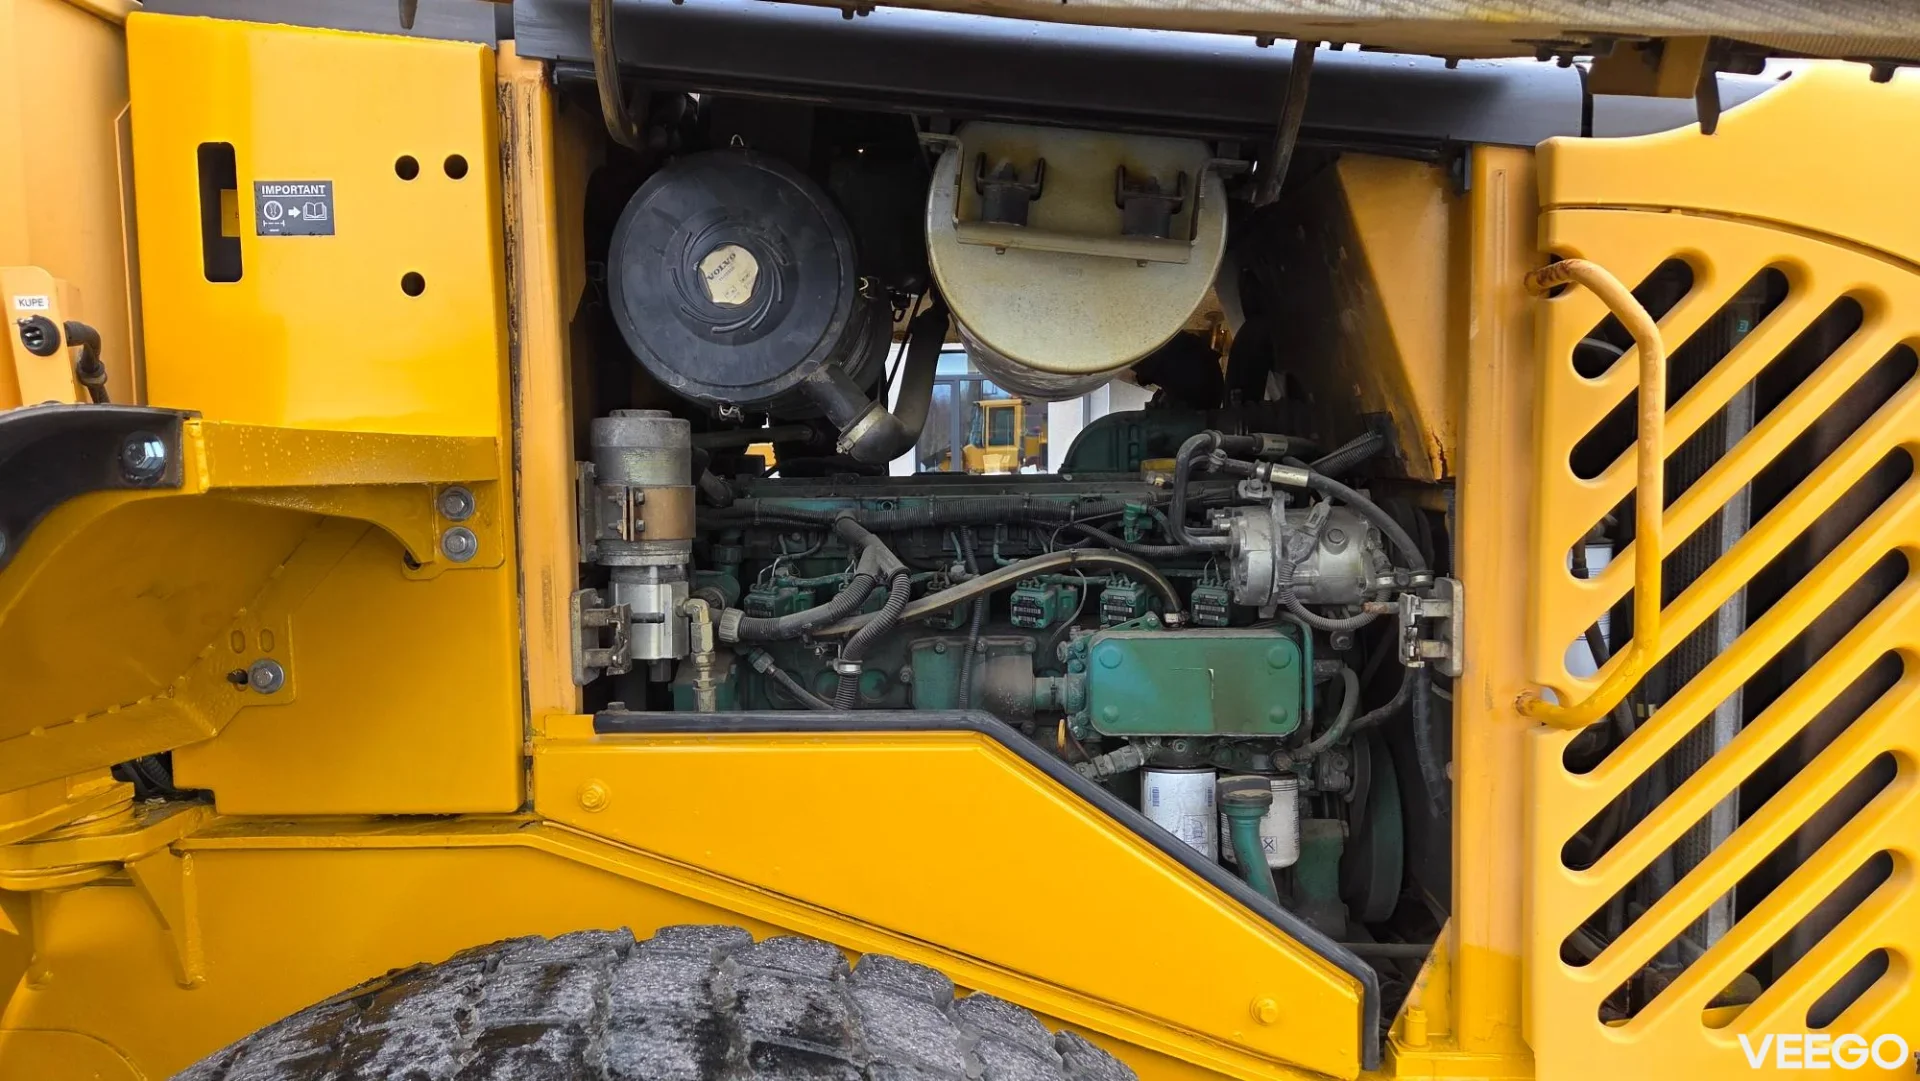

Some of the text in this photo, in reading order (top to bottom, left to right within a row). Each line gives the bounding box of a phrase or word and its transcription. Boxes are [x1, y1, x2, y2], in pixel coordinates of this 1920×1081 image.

[261, 184, 326, 195] IMPORTANT
[706, 252, 736, 281] VOLVO
[18, 297, 45, 307] KUPE
